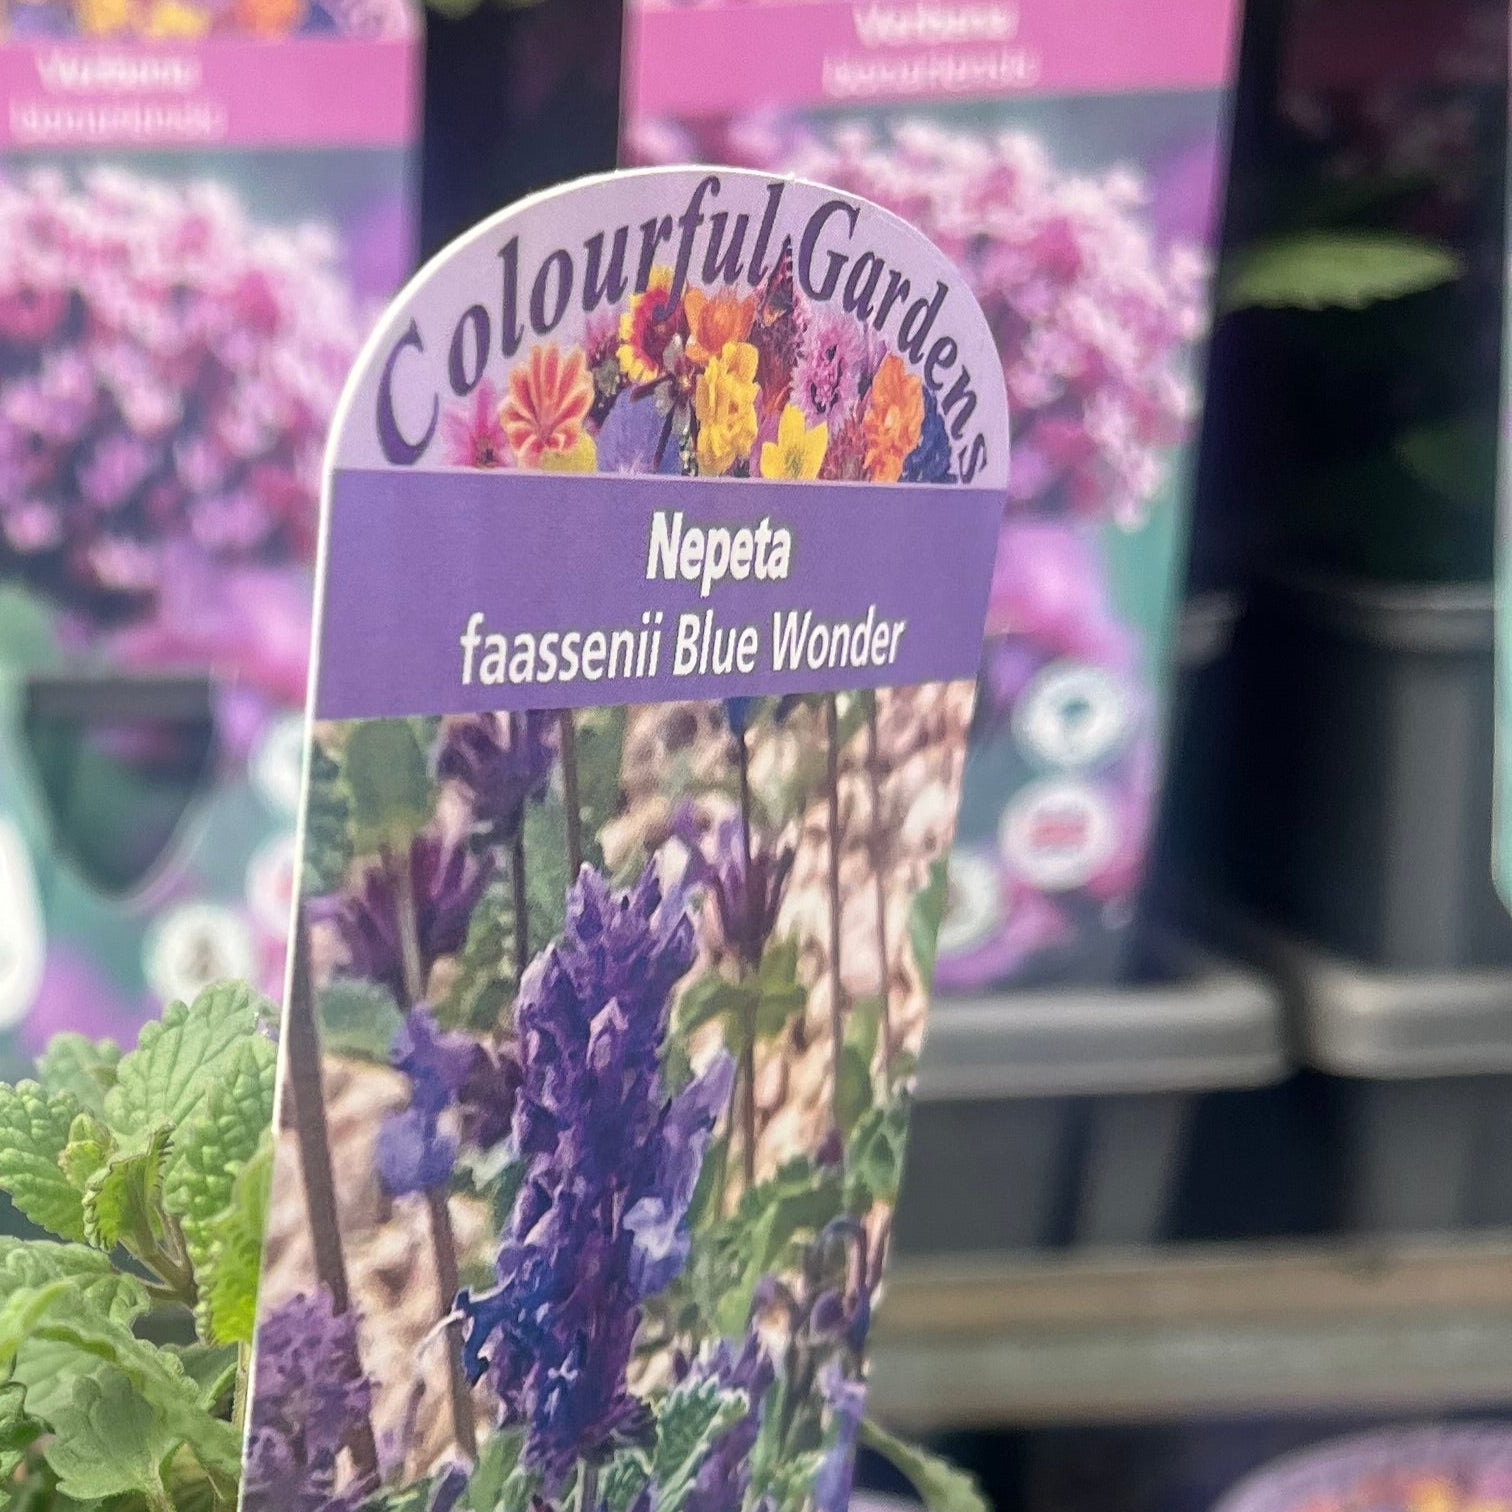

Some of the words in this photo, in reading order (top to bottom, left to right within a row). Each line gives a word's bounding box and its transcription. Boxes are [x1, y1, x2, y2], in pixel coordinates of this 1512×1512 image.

[376, 175, 785, 466] Colourful
[798, 199, 987, 484] Gardens
[646, 511, 790, 598] Nepeta
[460, 612, 662, 685] faassenii
[672, 609, 758, 676] Blue
[772, 605, 905, 671] Wonder
